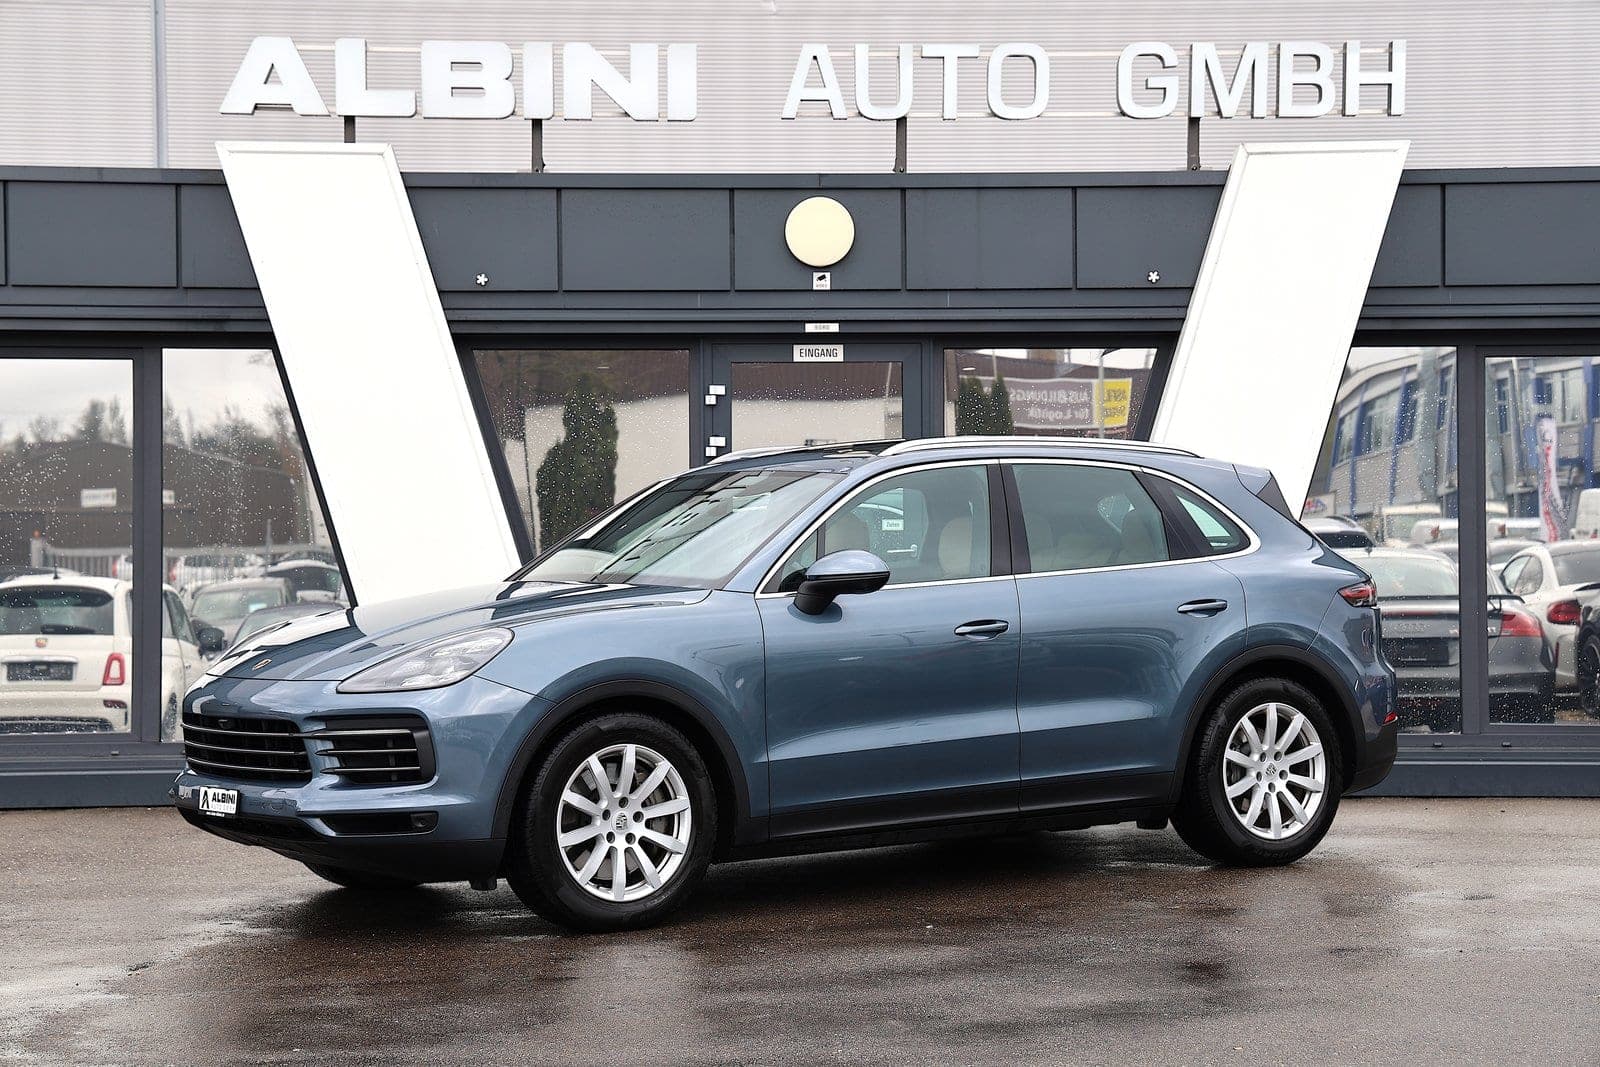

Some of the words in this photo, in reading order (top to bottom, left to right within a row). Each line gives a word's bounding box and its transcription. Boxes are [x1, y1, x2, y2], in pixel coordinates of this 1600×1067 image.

[219, 36, 698, 121] ALBINI
[781, 42, 1050, 120] AUTO
[1116, 39, 1408, 119] GMBH
[799, 348, 838, 358] EINGANG
[211, 792, 235, 804] ALBINI
